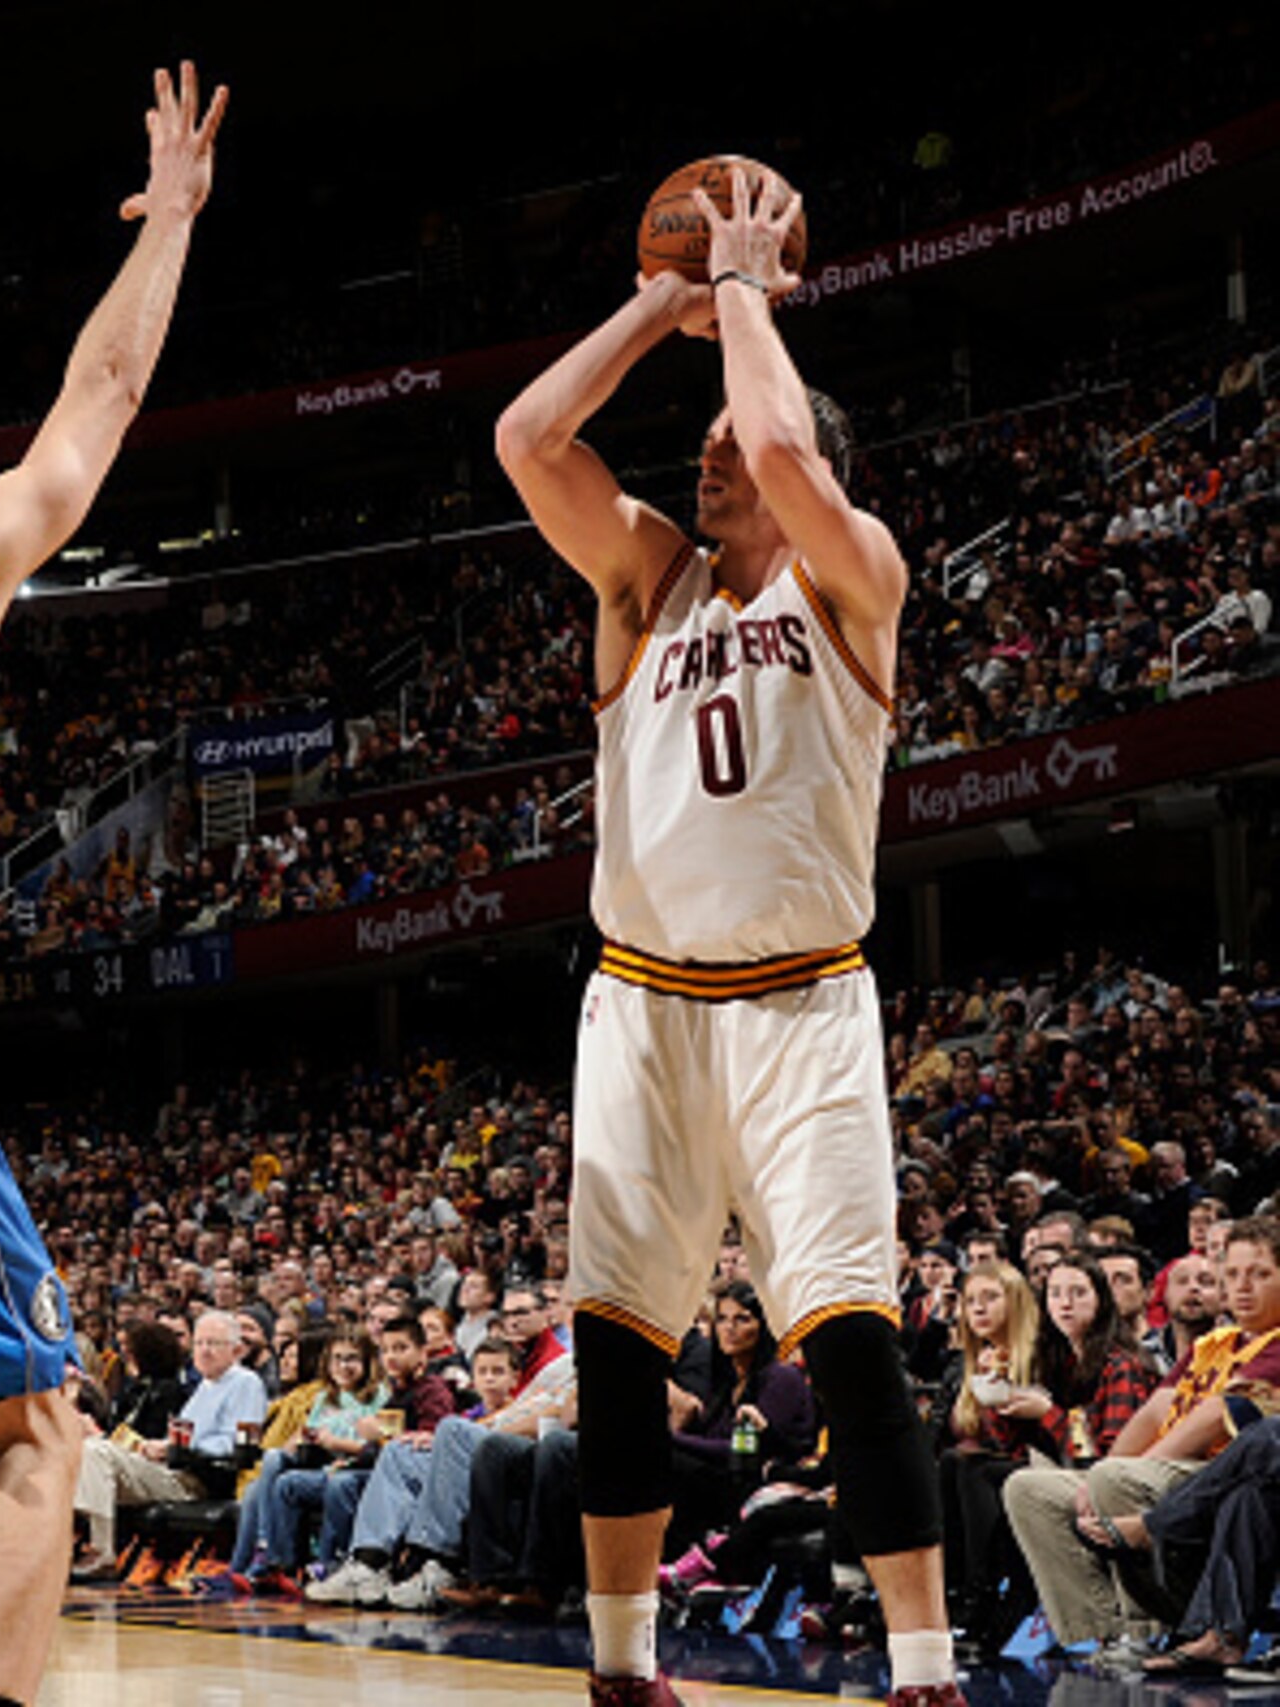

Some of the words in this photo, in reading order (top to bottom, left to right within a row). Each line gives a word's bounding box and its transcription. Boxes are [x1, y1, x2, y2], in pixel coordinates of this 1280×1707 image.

[899, 205, 1072, 274] Hassle-Free
[295, 379, 392, 416] KeyBank
[234, 718, 334, 759] HYUNDAI
[697, 694, 745, 798] 0
[906, 759, 1041, 824] KeyBank
[355, 900, 453, 954] KeyBank
[92, 953, 126, 998] 34
[150, 946, 196, 989] DAL
